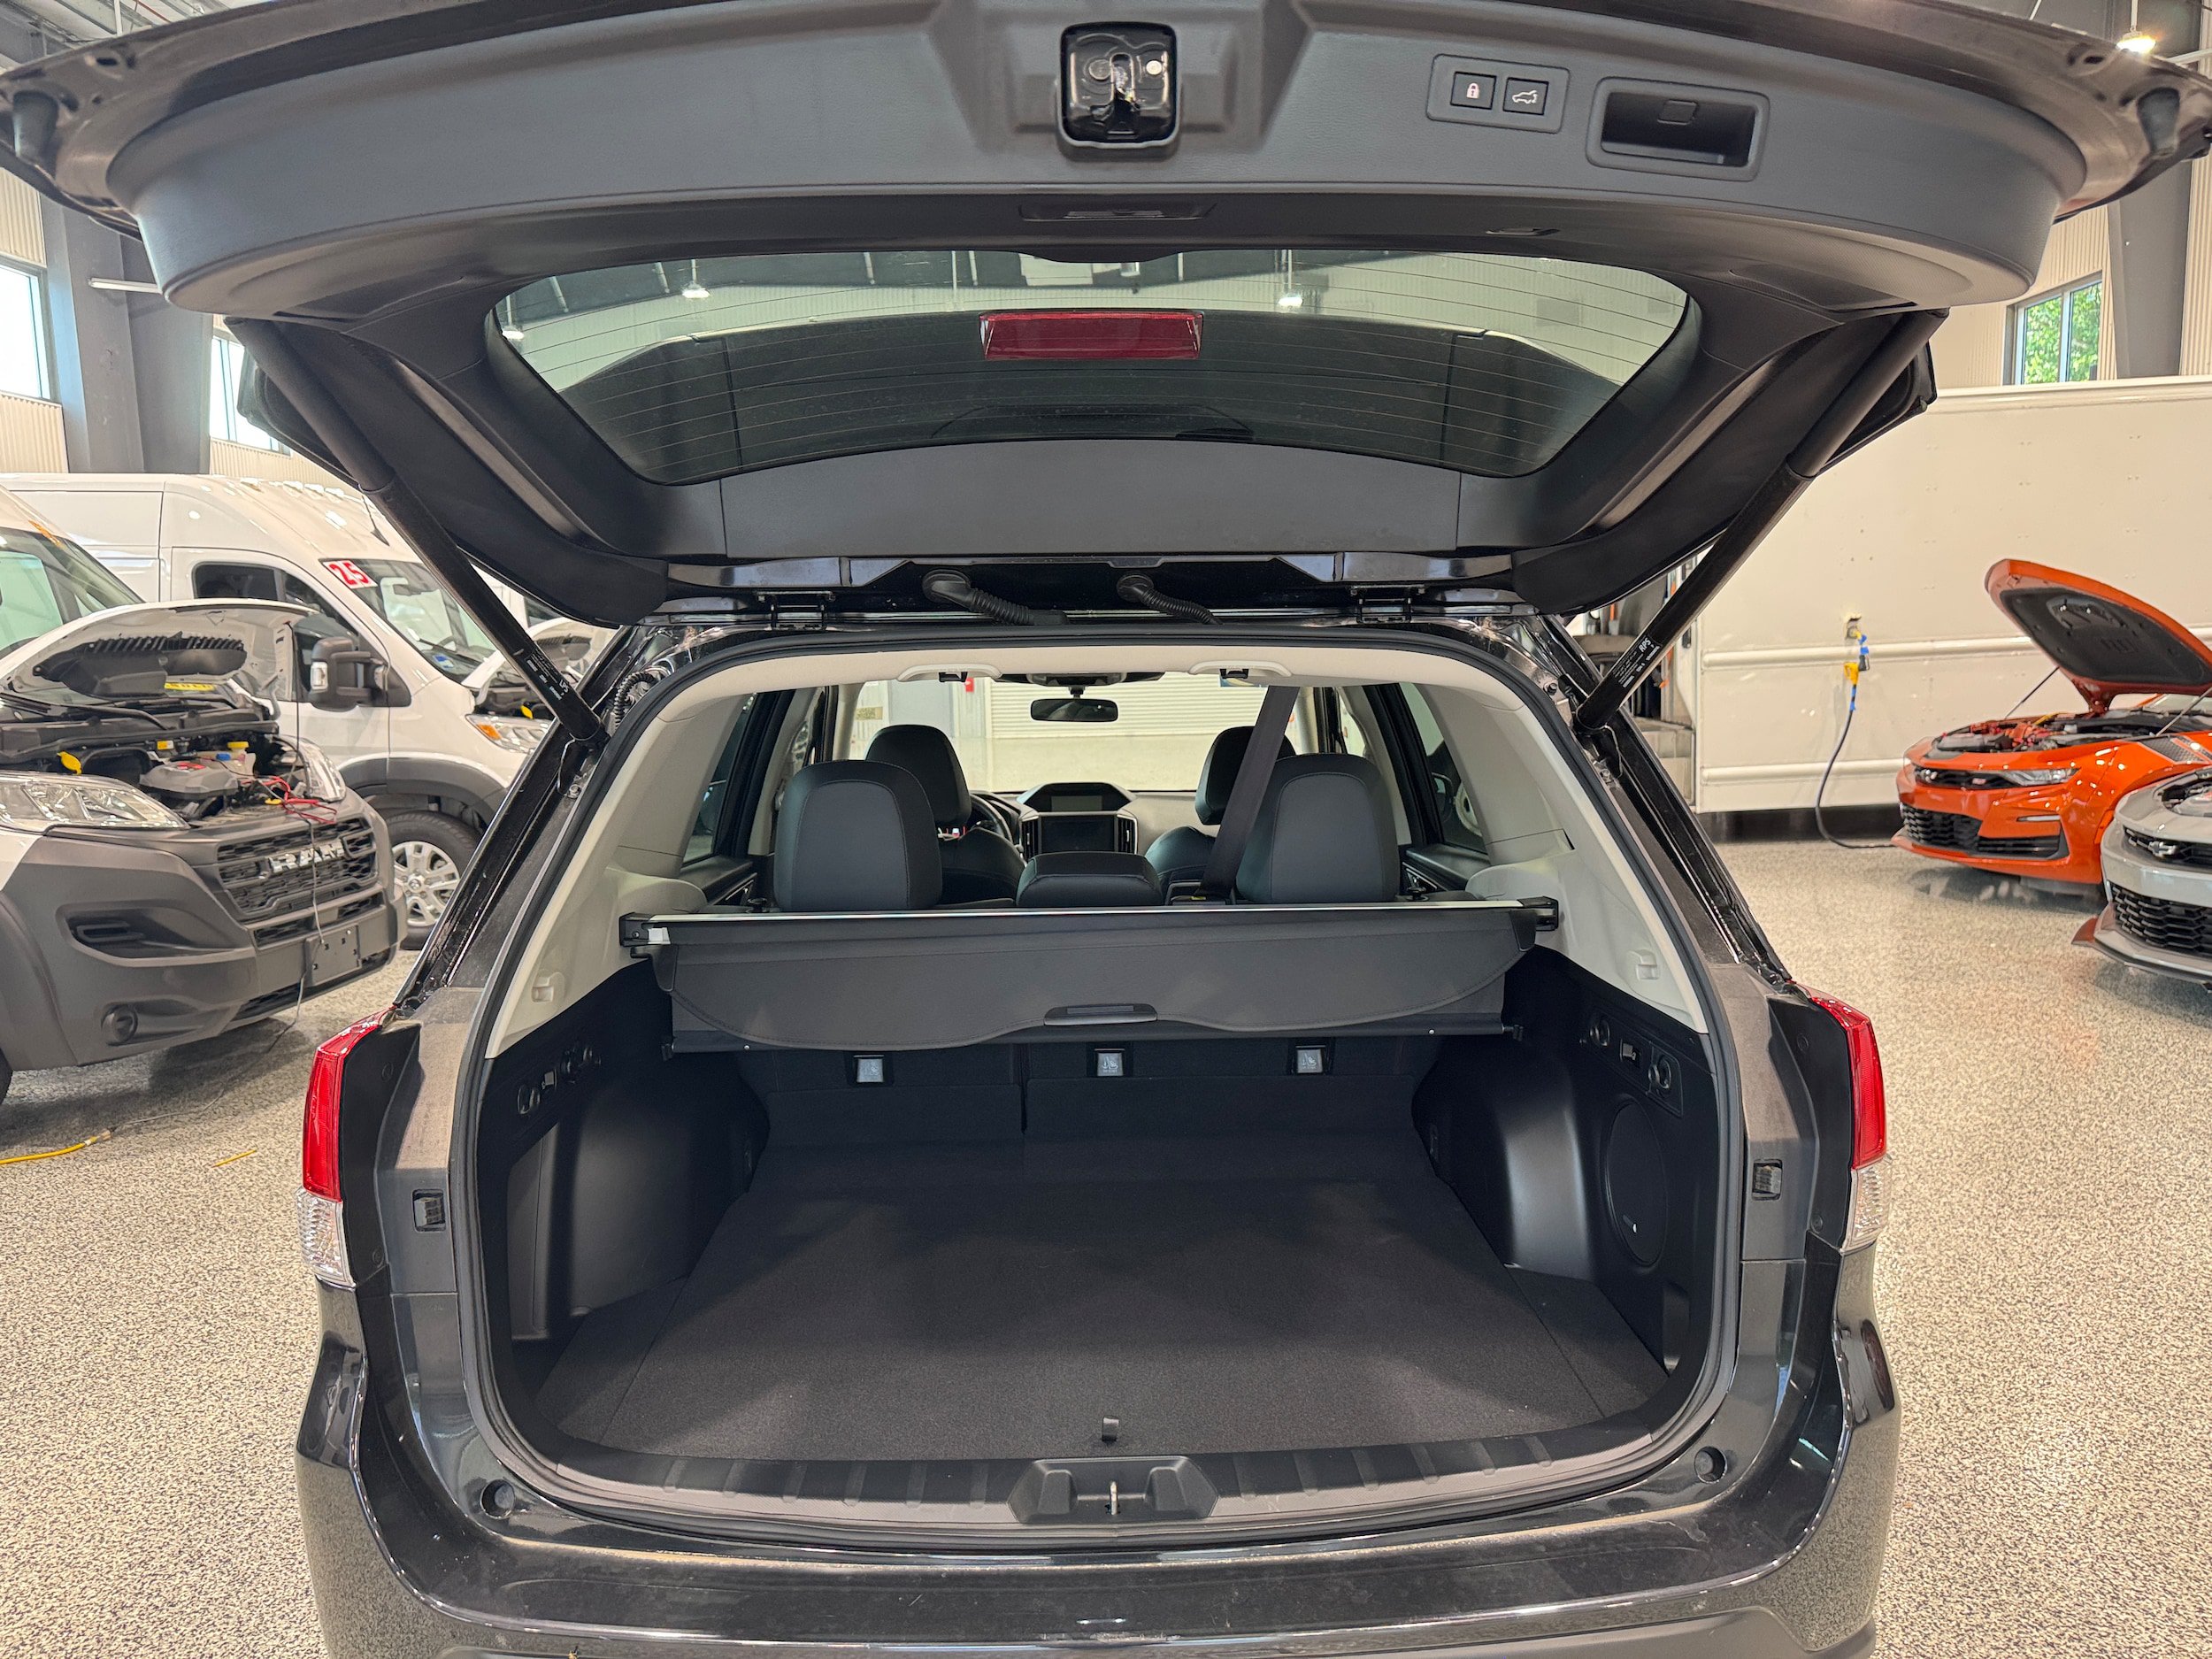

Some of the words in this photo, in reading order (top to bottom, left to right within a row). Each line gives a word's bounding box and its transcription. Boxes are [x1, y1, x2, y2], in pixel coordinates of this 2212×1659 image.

[328, 562, 369, 585] 25
[1639, 637, 1651, 653] RPS
[268, 839, 345, 873] RAM
